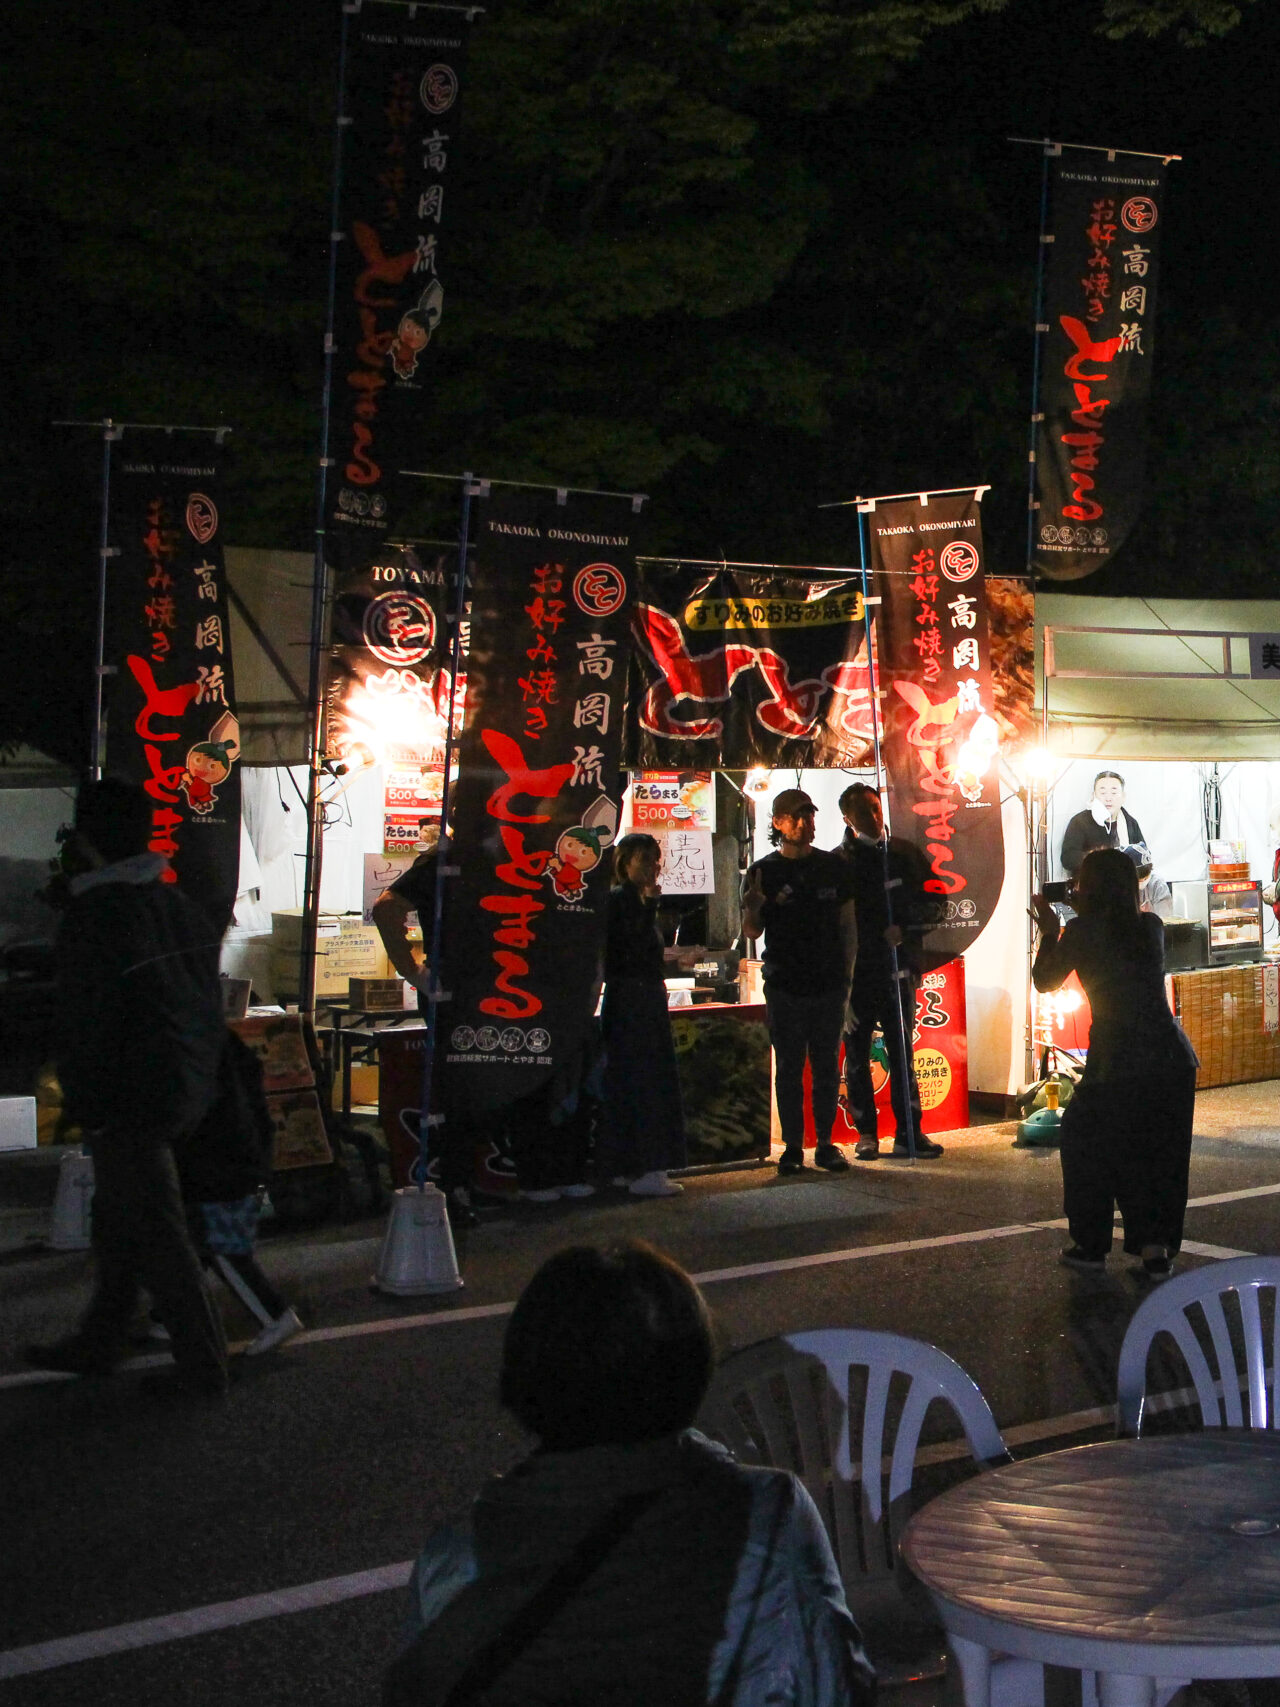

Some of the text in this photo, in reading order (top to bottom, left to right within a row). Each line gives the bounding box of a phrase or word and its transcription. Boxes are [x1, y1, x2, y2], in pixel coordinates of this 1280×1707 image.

[1059, 171, 1160, 187] TAKAOKA OKONOMIYAKI
[1080, 199, 1118, 323] お好み焼き
[1117, 244, 1151, 355] 高岡流
[488, 520, 630, 546] TAKAOKA OKONOMIYAKI
[876, 518, 977, 536] TAKAOKA OKONOMIYAKI
[371, 566, 445, 585] TOYAMA
[694, 597, 859, 625] すりみのお好み焼き
[908, 547, 945, 683] お好み焼き
[192, 559, 230, 707] 高岡流
[517, 558, 567, 740] お好み焼き
[947, 594, 986, 714] 高岡流
[570, 633, 617, 791] 高岡流
[388, 788, 412, 800] 500
[634, 784, 679, 800] たらまる
[638, 805, 668, 820] 500
[386, 826, 419, 838] たらまる
[388, 841, 411, 853] 500
[922, 973, 947, 989] 焼き
[916, 990, 950, 1027] る
[512, 1055, 535, 1065] とやま
